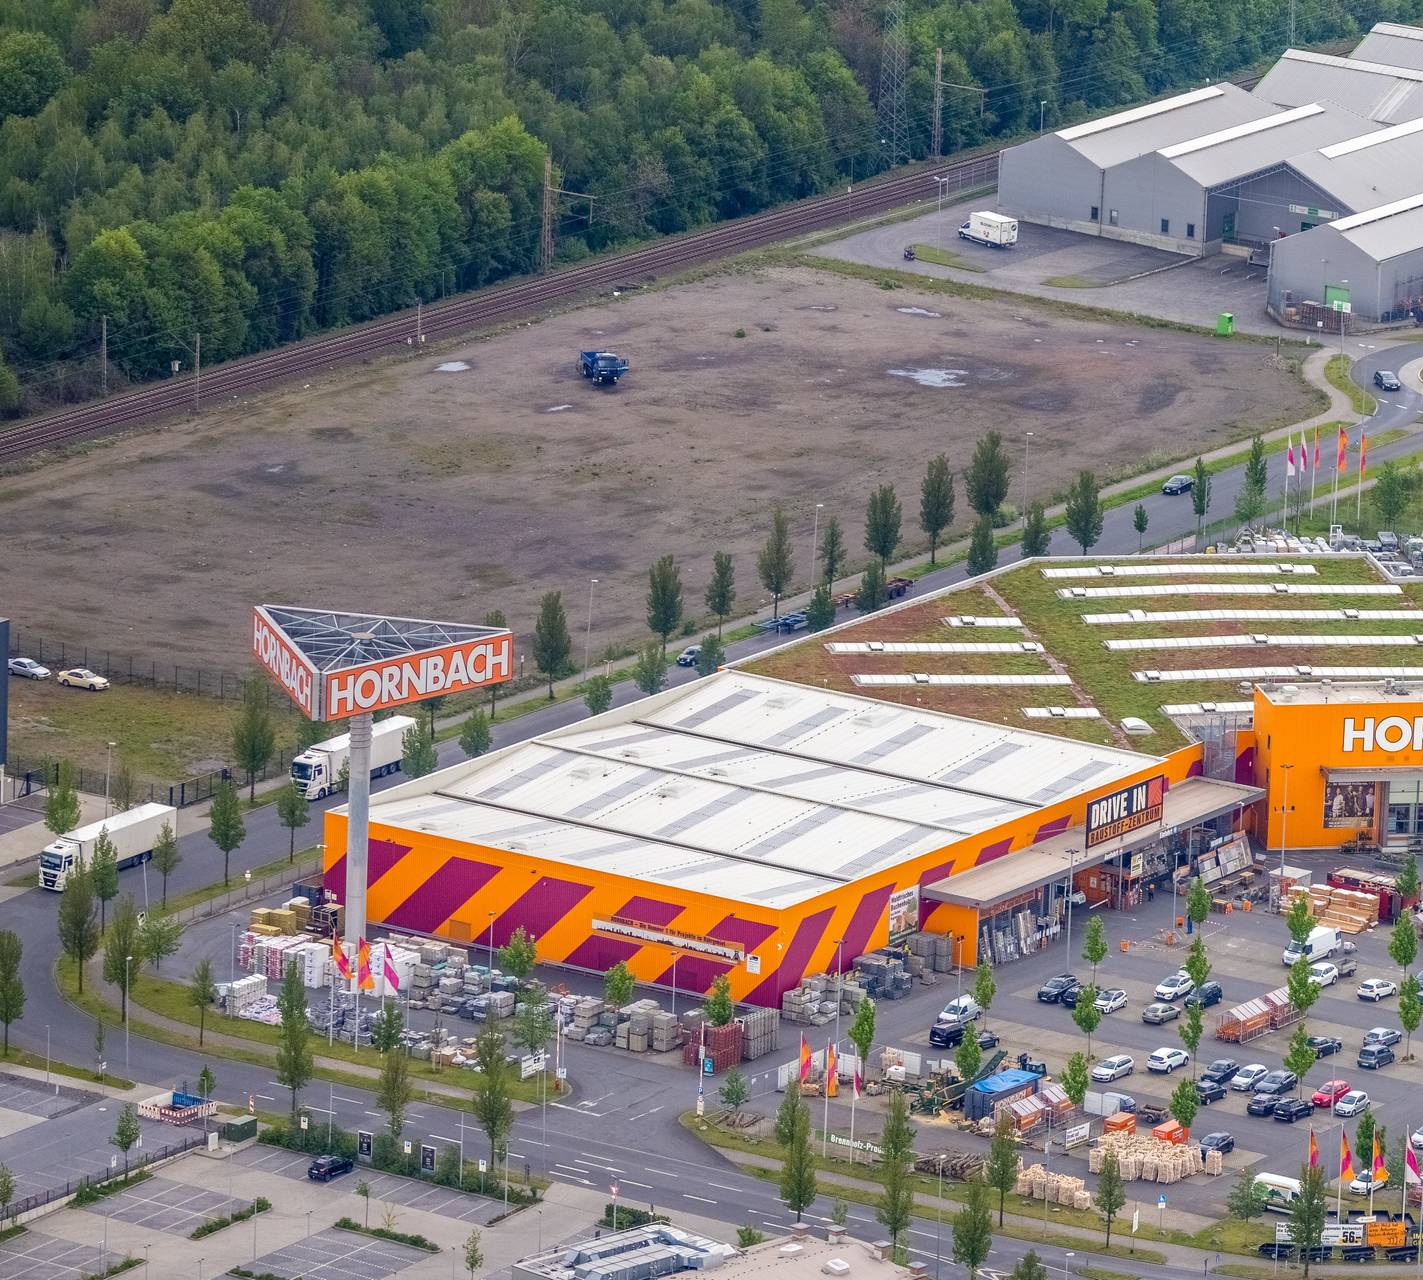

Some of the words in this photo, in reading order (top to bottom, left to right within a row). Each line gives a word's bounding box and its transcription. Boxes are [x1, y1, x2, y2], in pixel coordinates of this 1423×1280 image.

[253, 615, 313, 713] HORNBACH
[329, 639, 510, 715] HORNBACH
[1089, 806, 1161, 844] BAUSTOFF-ZENTRUM
[1091, 791, 1129, 829] DRIVE
[1132, 784, 1147, 813] IN
[830, 1134, 885, 1154] Brennholz-Prod
